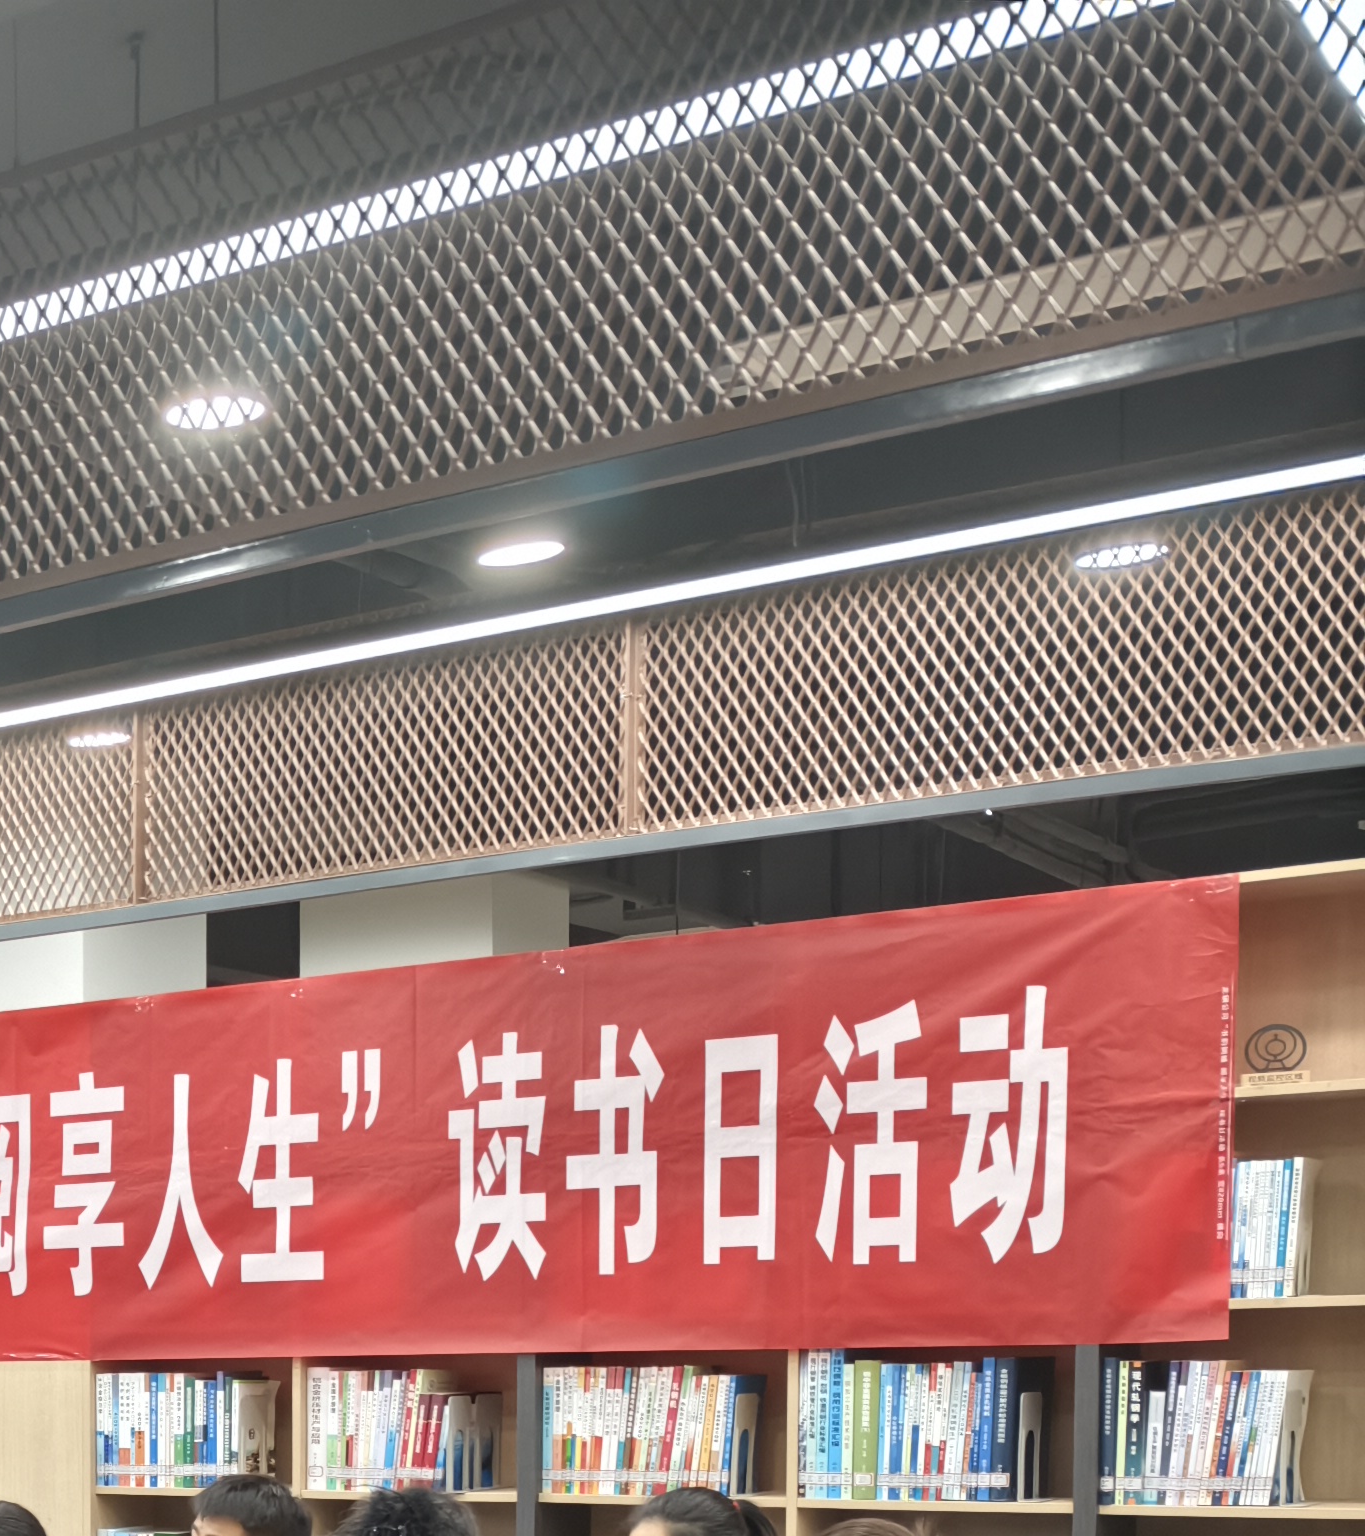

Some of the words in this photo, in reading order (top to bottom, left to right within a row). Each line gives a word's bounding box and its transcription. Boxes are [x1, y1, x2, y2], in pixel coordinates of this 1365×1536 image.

[447, 984, 1070, 1283] 读书日活动
